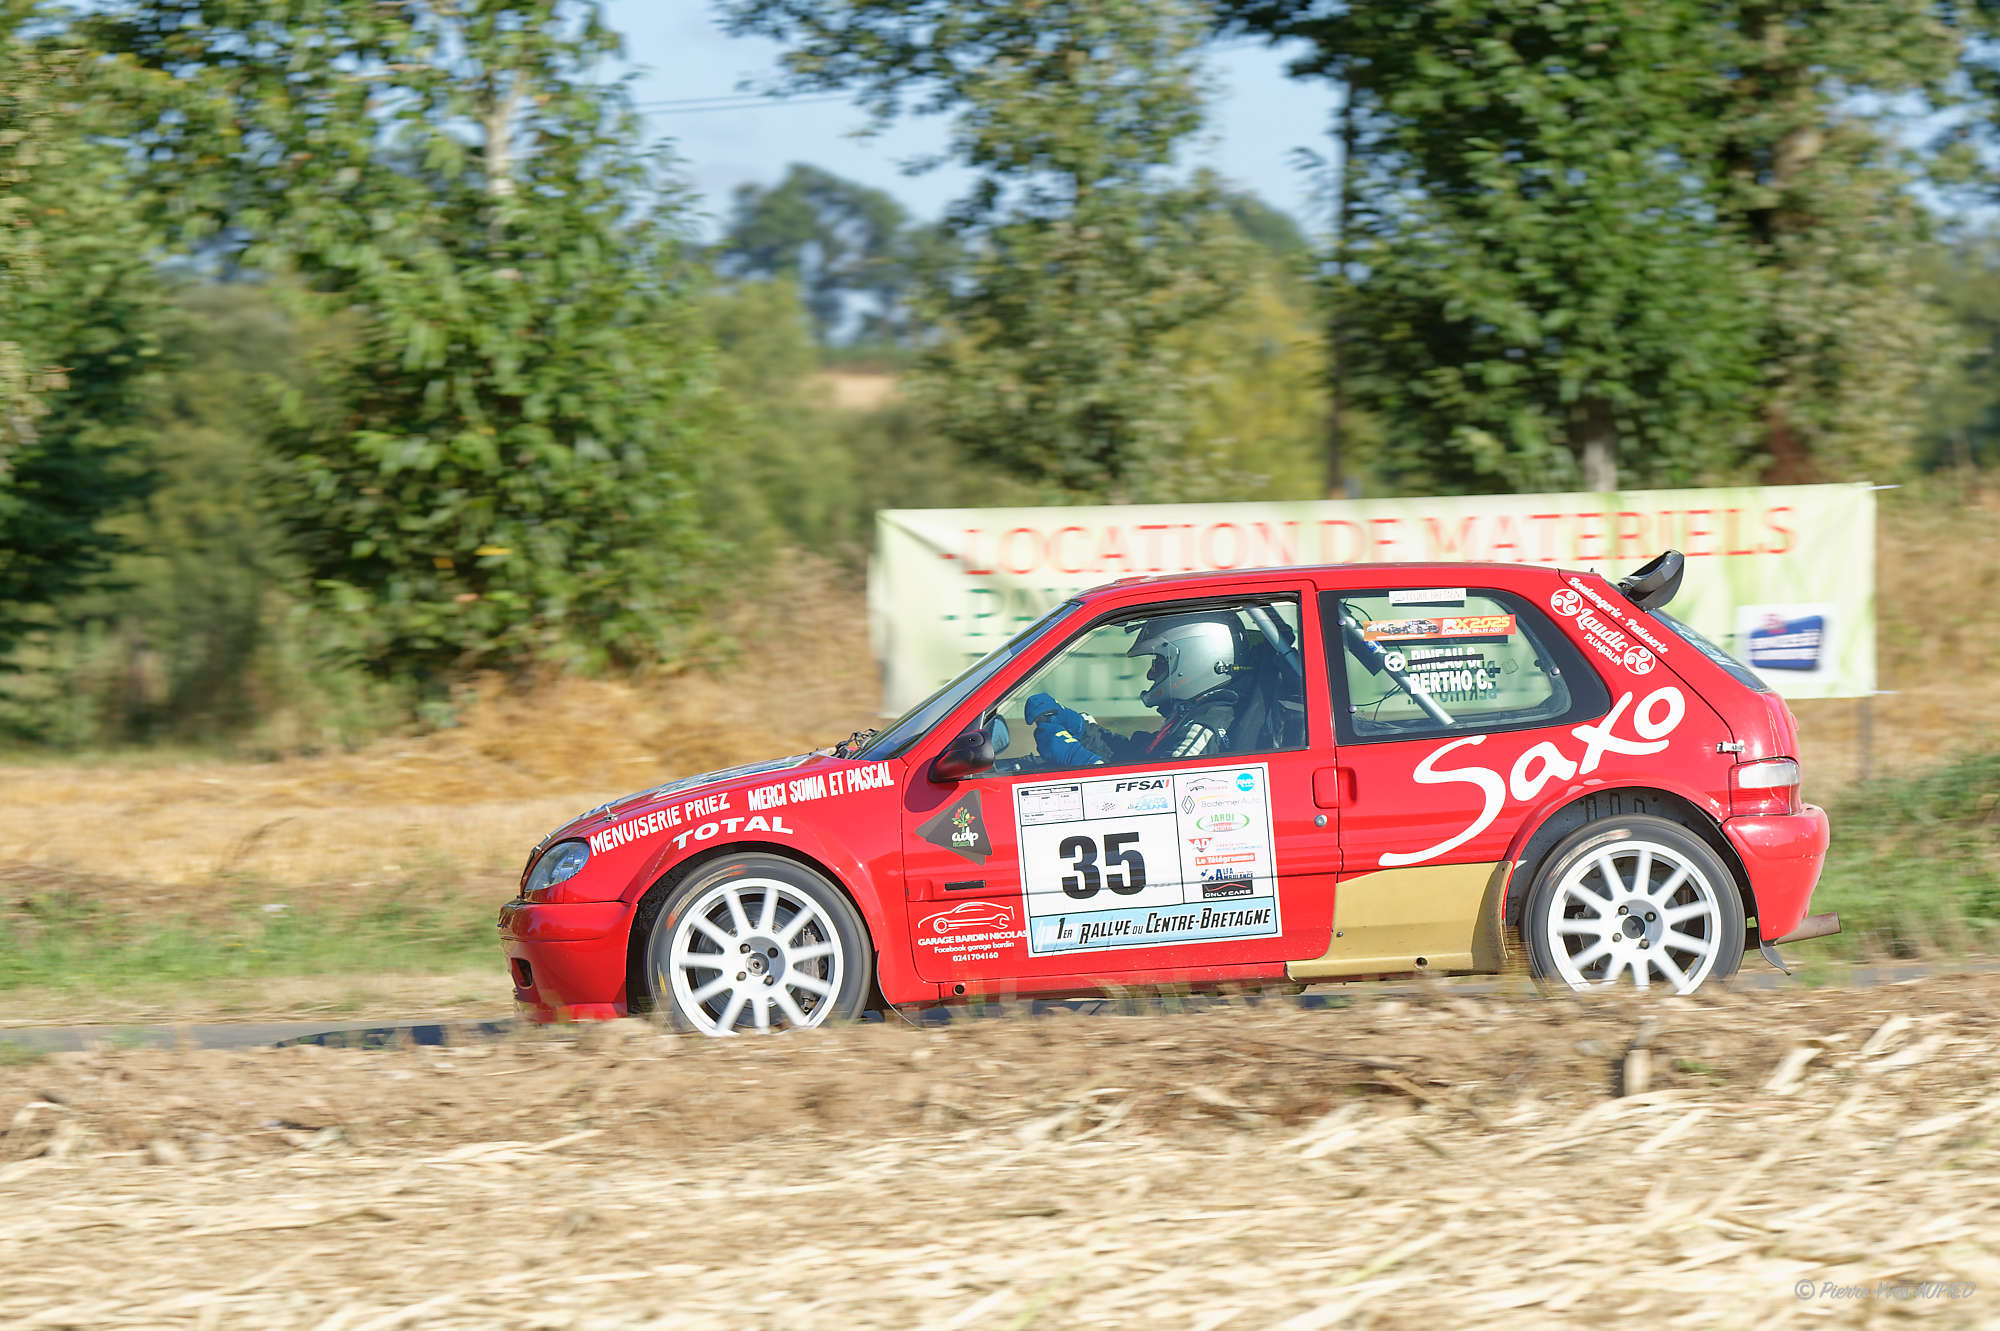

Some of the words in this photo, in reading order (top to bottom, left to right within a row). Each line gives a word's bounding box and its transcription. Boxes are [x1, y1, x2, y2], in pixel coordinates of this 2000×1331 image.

[1318, 517, 1401, 564] DE
[1423, 505, 1801, 563] MATERIELS
[1568, 577, 1622, 618] Boulangerie
[1576, 608, 1628, 652] Laudic
[1409, 669, 1473, 695] BERTHO
[1476, 668, 1494, 690] C.
[748, 783, 787, 811] MERCI
[789, 774, 827, 804] SONIA
[829, 770, 844, 796] ET
[846, 761, 894, 793] PASCAL
[1115, 780, 1163, 793] FFSA
[1379, 686, 1686, 867] Saxo
[590, 805, 682, 856] MENUISERIE
[685, 792, 731, 821] PRIEZ
[672, 816, 793, 850] TOTAL
[952, 827, 979, 847] adp
[1058, 831, 1147, 899] 35
[1204, 890, 1227, 898] ONLY
[917, 936, 954, 946] GARAGE
[955, 934, 988, 943] BARDIN
[989, 930, 1028, 940] NICOLAS
[1079, 919, 1131, 945] RALLYE
[1145, 907, 1272, 934] CENTRE-BRETAGNE
[934, 944, 966, 954] Facebook
[967, 943, 992, 952] garage
